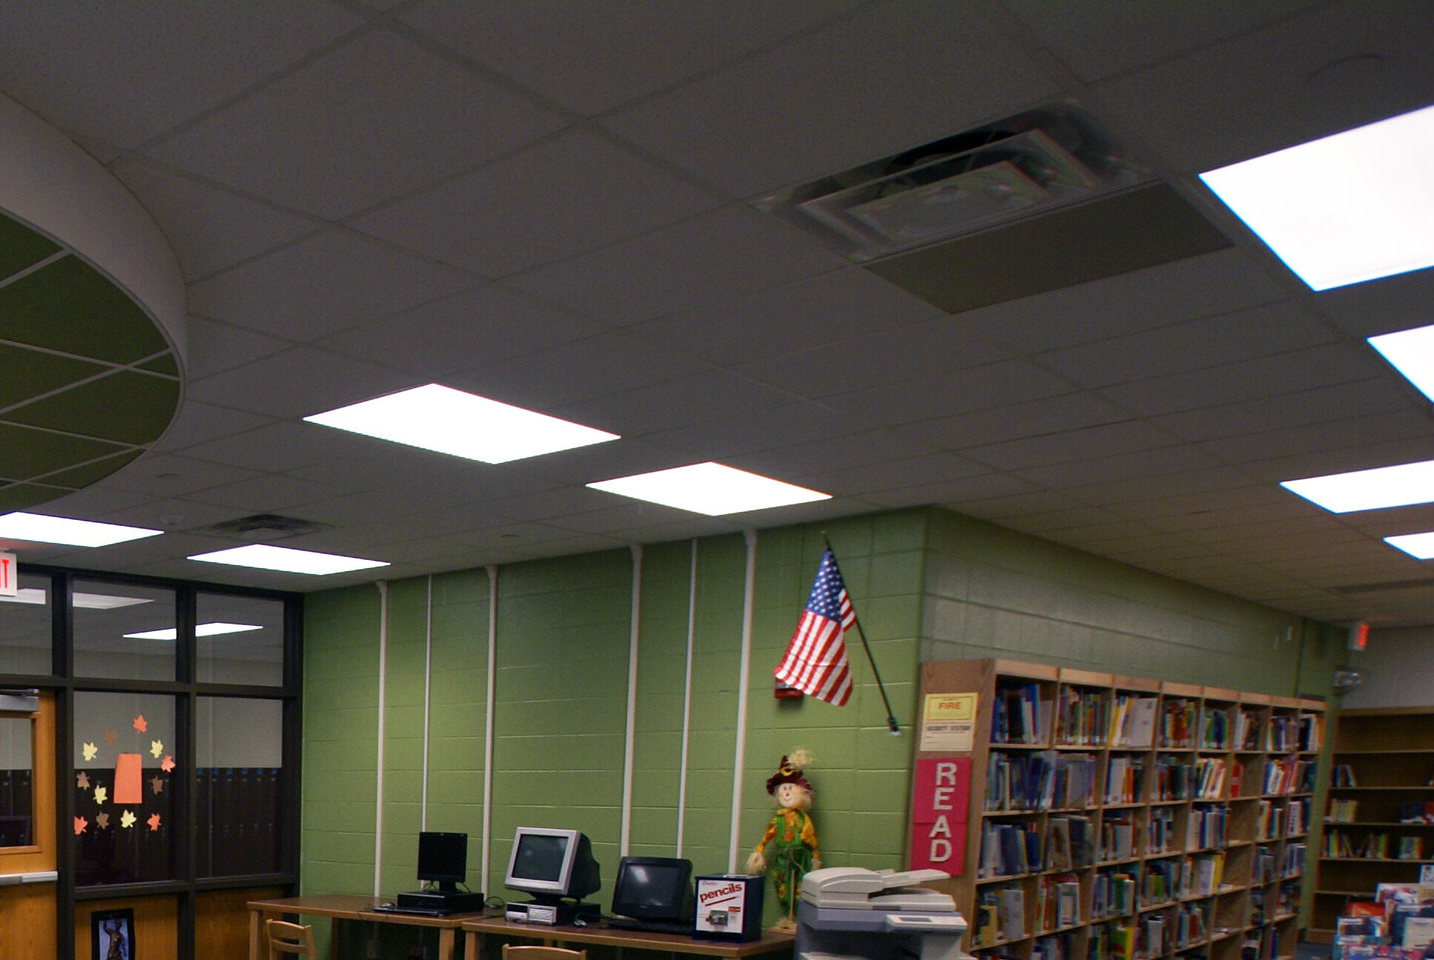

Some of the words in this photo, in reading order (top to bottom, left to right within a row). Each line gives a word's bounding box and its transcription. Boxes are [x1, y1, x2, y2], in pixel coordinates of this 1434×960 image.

[938, 702, 961, 710] FIRE
[929, 762, 957, 862] READ
[700, 883, 742, 903] pencils
